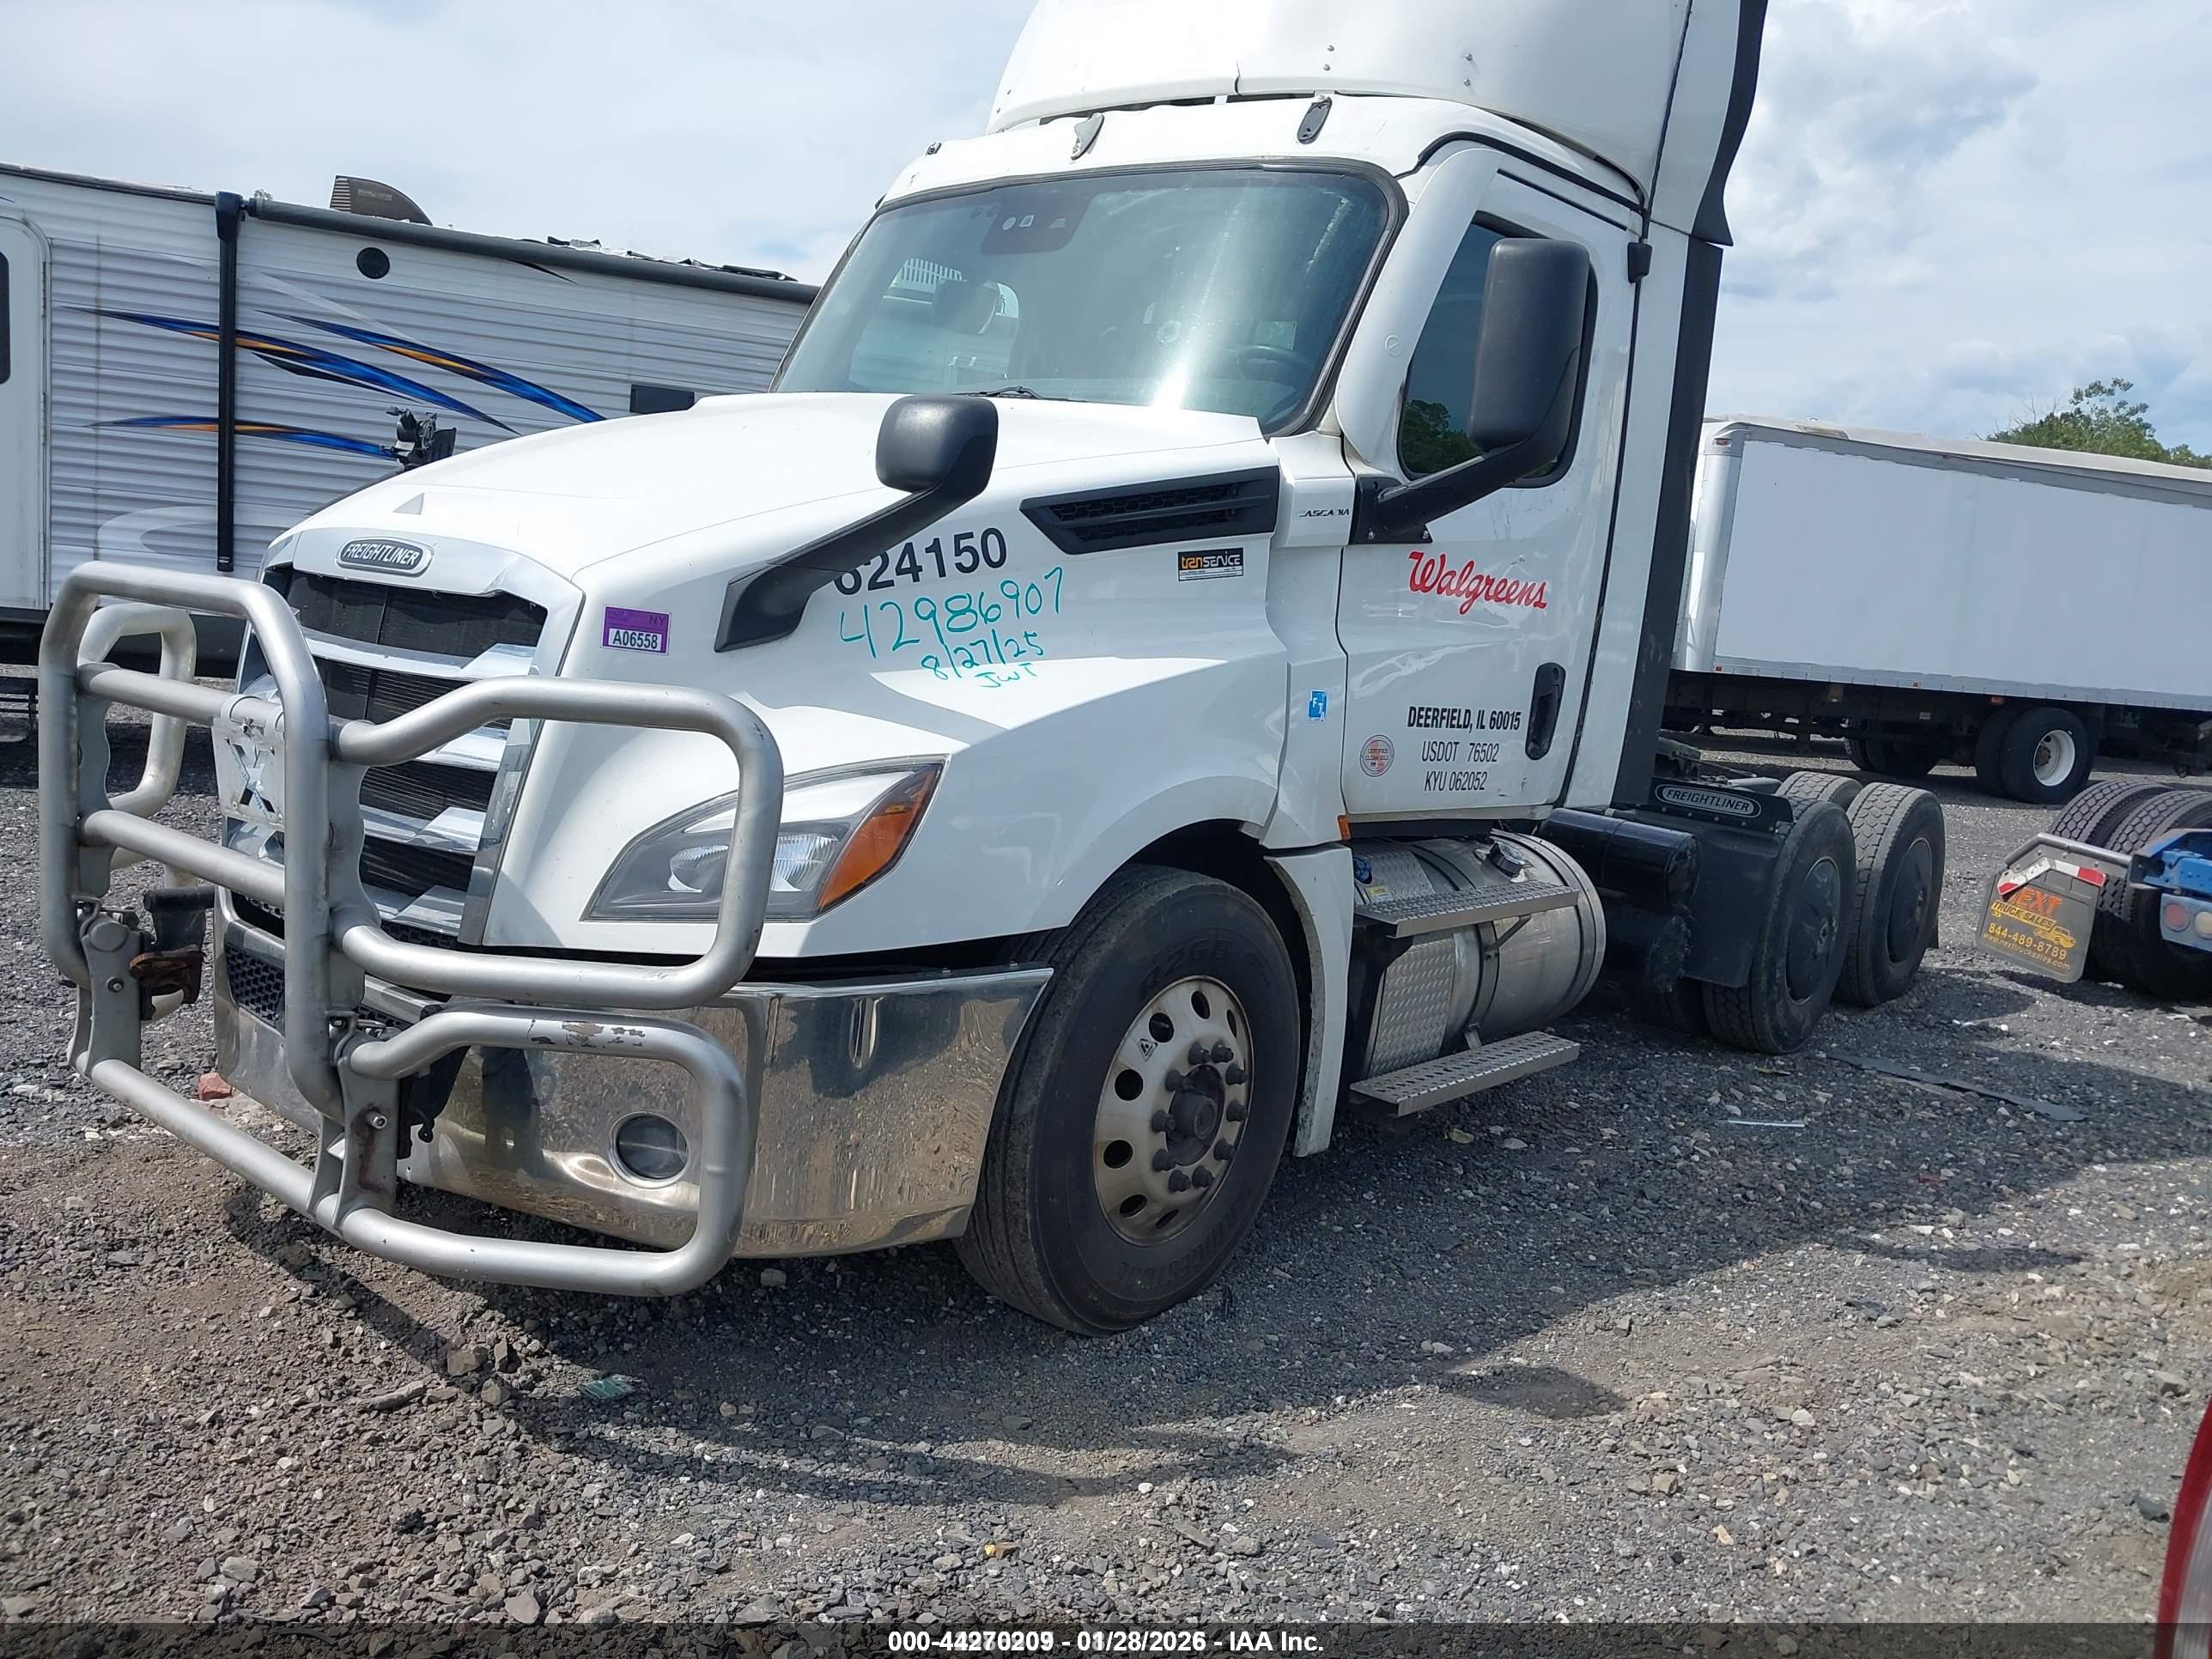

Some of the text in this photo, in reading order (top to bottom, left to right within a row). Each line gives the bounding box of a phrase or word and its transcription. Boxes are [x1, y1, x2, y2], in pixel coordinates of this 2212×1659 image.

[343, 543, 420, 565] FREIGHTLINER
[1408, 551, 1547, 615] Walgreens
[649, 615, 665, 626] NY
[840, 567, 1062, 659] 42986907
[612, 630, 658, 649] A06558
[921, 629, 1043, 680] 8/27/25
[1407, 706, 1522, 733] DEERFIELD, IL 60015
[1422, 741, 1499, 762] USDOT 76502
[1424, 771, 1488, 792] KYU 062052
[1666, 789, 1749, 811] FREIGHTLINER
[1992, 902, 2053, 928] TRUCK SALES
[1989, 923, 2067, 960] 844-489-8789
